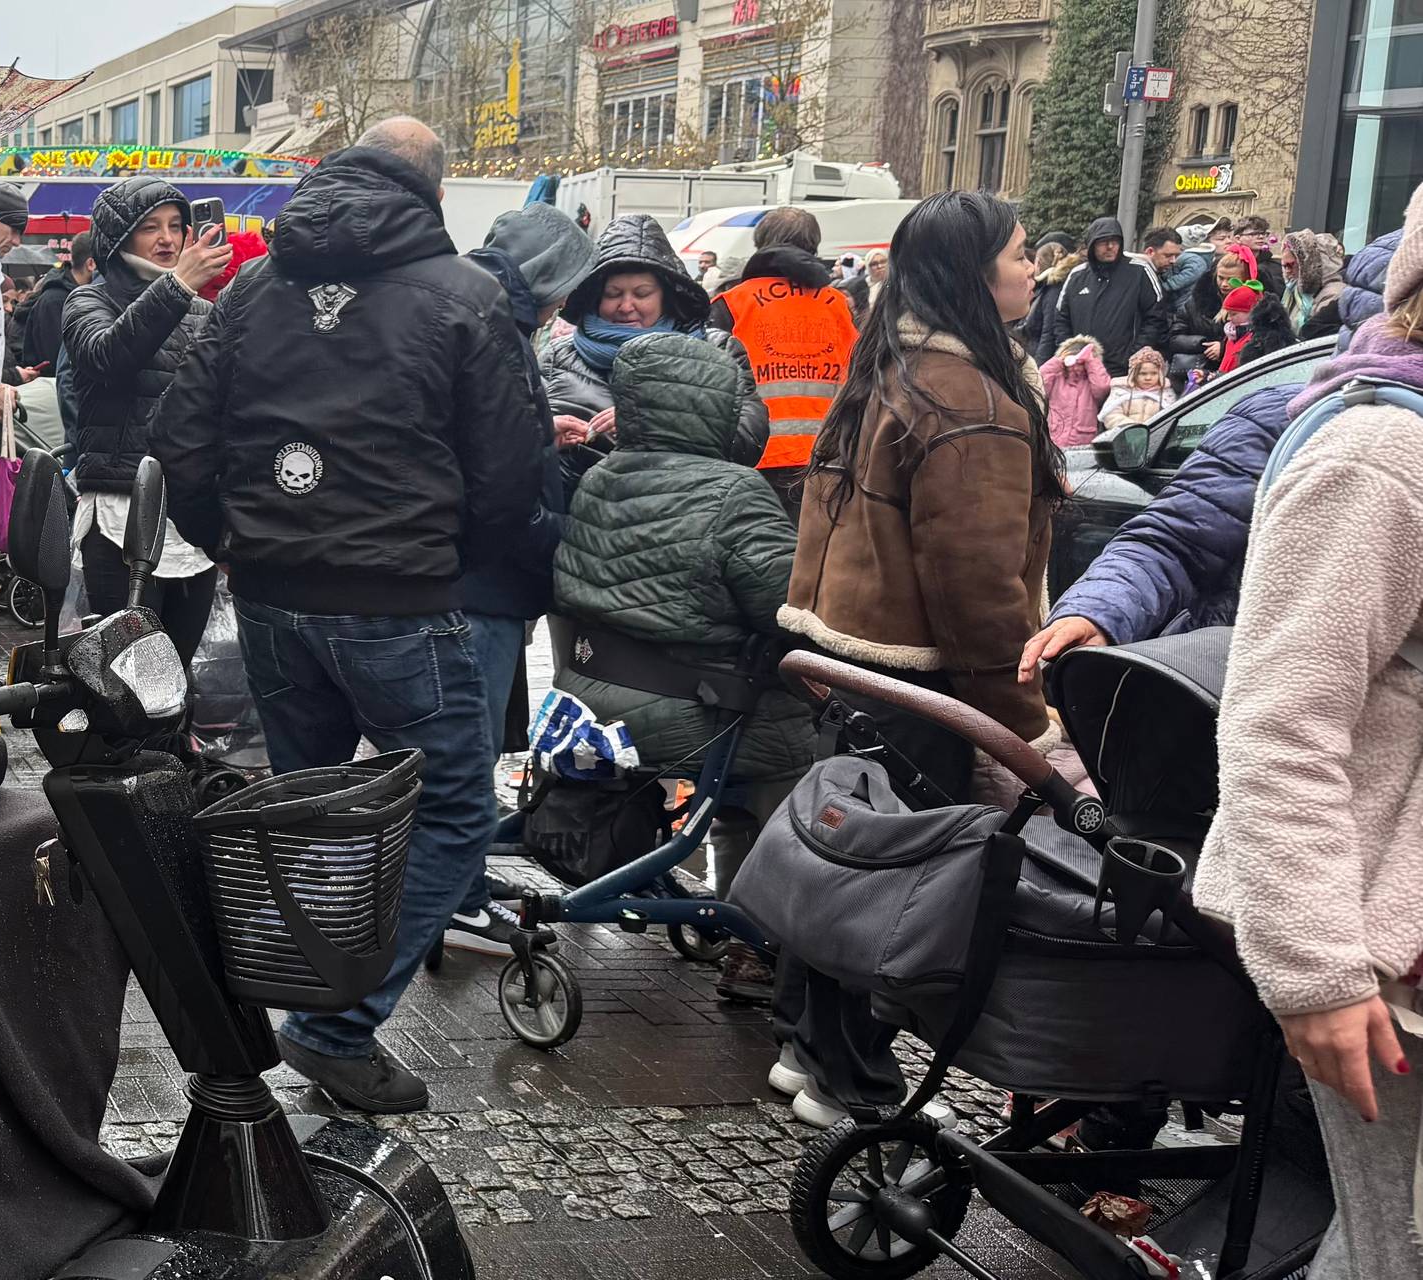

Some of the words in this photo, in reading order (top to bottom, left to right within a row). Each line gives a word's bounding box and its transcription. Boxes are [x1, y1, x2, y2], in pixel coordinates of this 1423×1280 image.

[31, 150, 98, 168] NEW
[1174, 173, 1216, 191] Oshusi
[756, 360, 841, 383] Mittelstr.22
[273, 441, 324, 478] HARLEY-DAVIDSON
